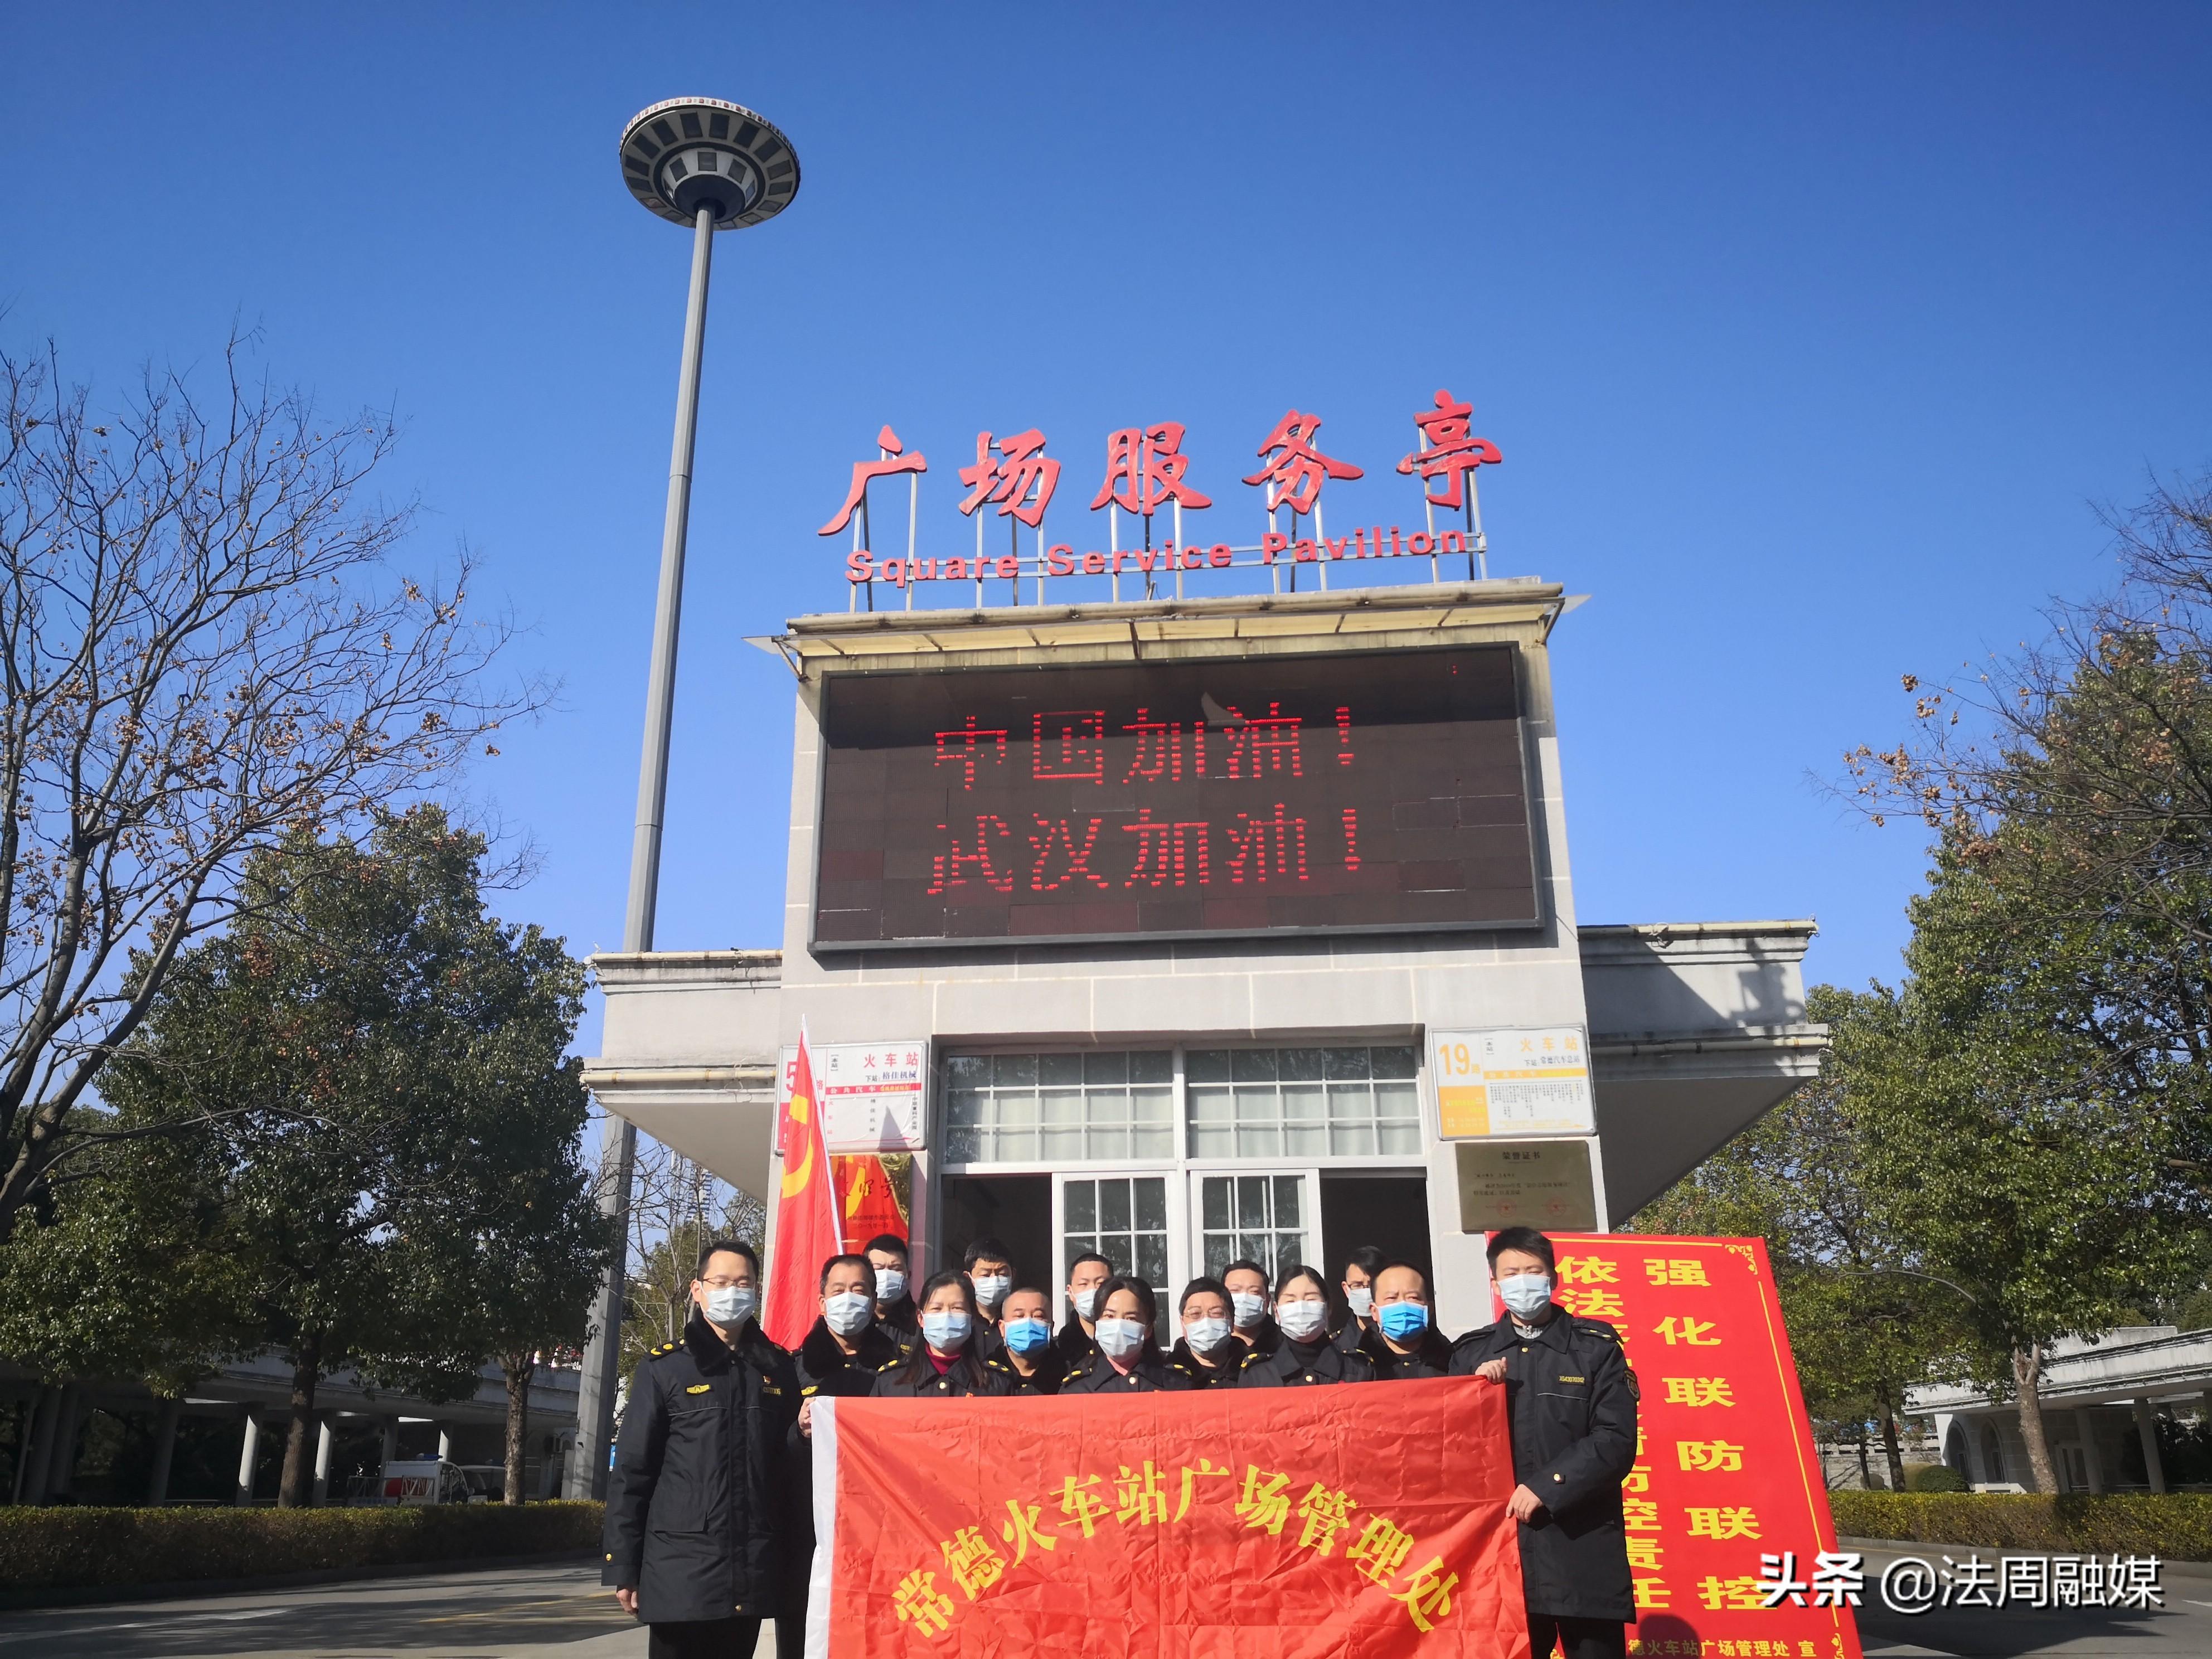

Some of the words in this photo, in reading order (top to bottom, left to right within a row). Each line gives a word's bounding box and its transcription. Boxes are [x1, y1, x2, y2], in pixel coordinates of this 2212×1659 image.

[818, 389, 1502, 536] 广场服务亭
[845, 549, 1019, 589] Square
[1047, 539, 1233, 576] Service
[1262, 526, 1466, 564] Pavilion
[864, 1051, 919, 1068] 火车站
[1520, 1035, 1578, 1052] 火车站
[1502, 1151, 1540, 1160] 荣誉证书
[1642, 1258, 1777, 1611] 强化联防联控
[892, 1458, 1459, 1638] 常德火车站广场管理处
[1798, 1641, 1817, 1657] 宣
